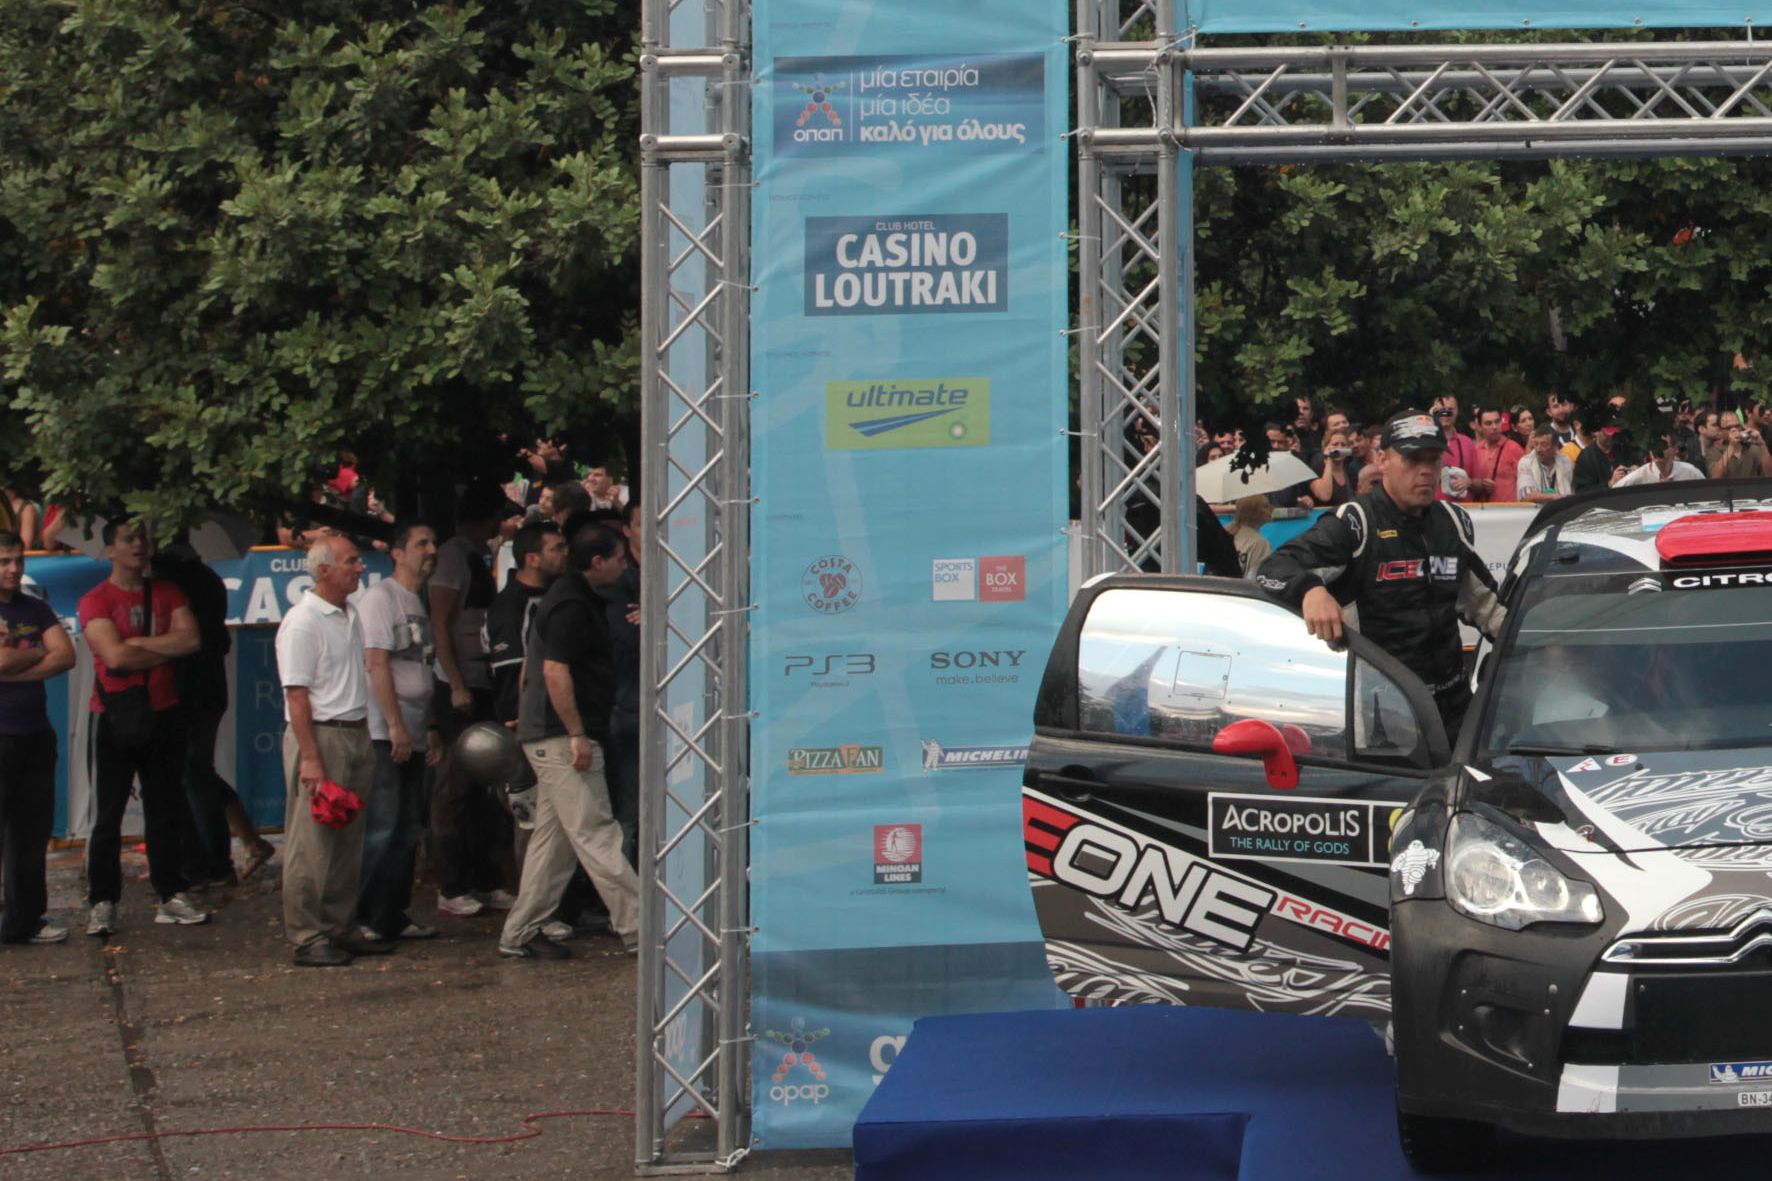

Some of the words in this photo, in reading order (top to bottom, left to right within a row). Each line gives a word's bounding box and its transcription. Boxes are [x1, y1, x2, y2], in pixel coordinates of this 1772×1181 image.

[875, 221, 902, 232] CLUB
[903, 220, 936, 231] HOTEL
[836, 230, 977, 268] CASINO
[815, 269, 997, 309] LOUTRAKI
[846, 383, 969, 408] ultimate
[810, 557, 853, 575] COSTA
[934, 562, 973, 572] SPORTS
[934, 572, 960, 582] BOX
[985, 572, 1017, 586] BOX
[808, 591, 858, 612] COFFEE
[784, 653, 876, 677] PS3
[930, 650, 1026, 670] SONY
[790, 749, 843, 769] PIZZA
[1221, 804, 1361, 837] ACROPOLIS
[1229, 836, 1253, 850] THE
[1255, 837, 1291, 852] RALLY
[1293, 840, 1310, 853] OF
[1312, 841, 1350, 855] GODS
[876, 864, 920, 874] MINOAN
[883, 873, 912, 883] LINES
[769, 1083, 830, 1107] opap
